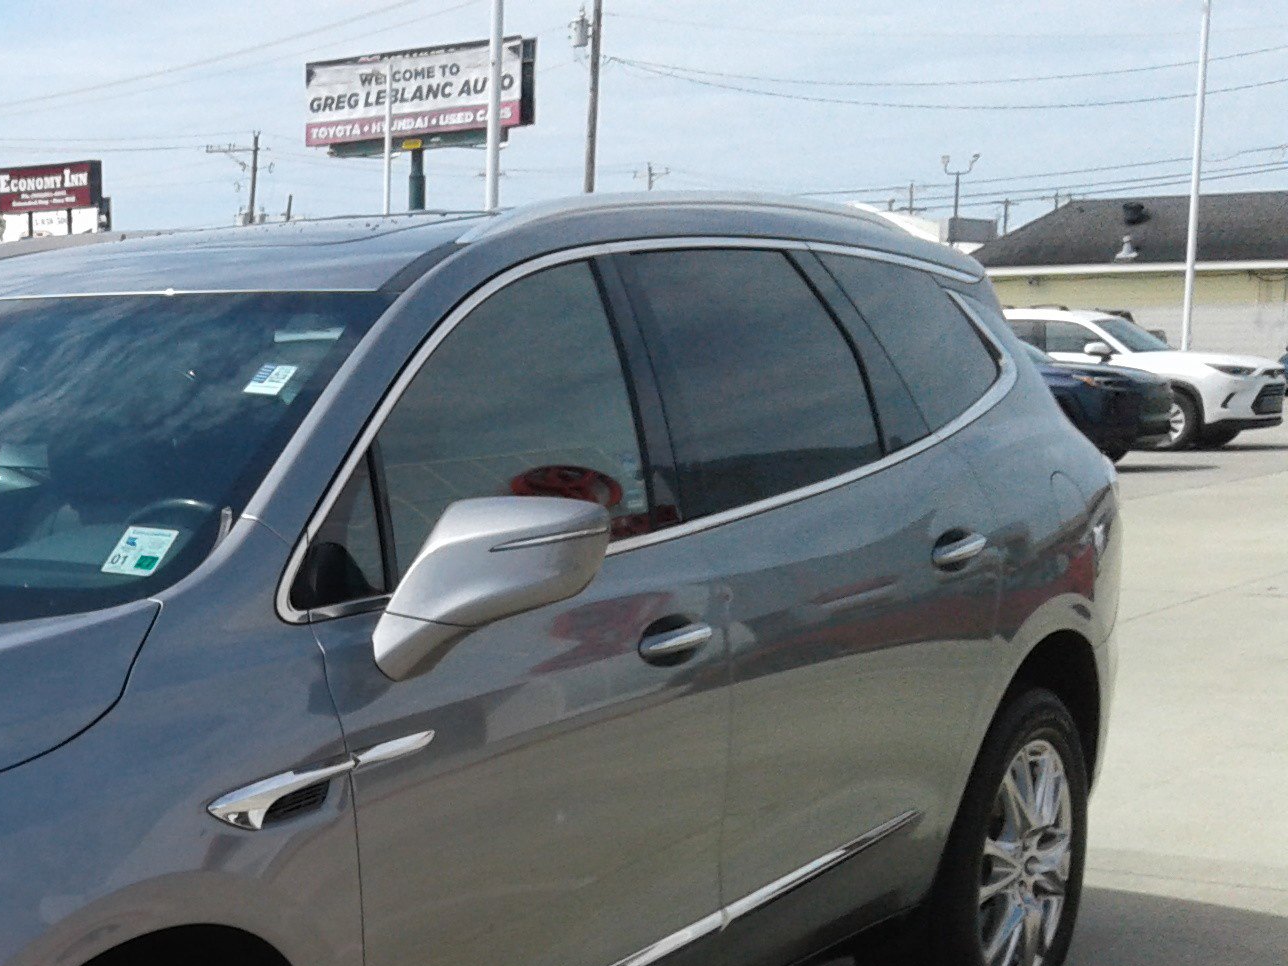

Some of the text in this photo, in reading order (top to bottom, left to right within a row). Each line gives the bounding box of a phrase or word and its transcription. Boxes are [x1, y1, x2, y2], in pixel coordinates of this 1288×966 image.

[359, 63, 460, 88] WECOME TO
[309, 92, 359, 113] GREG
[457, 73, 514, 97] AUO
[311, 122, 361, 139] TOYOTA
[439, 111, 474, 126] USED
[476, 107, 512, 122] CS
